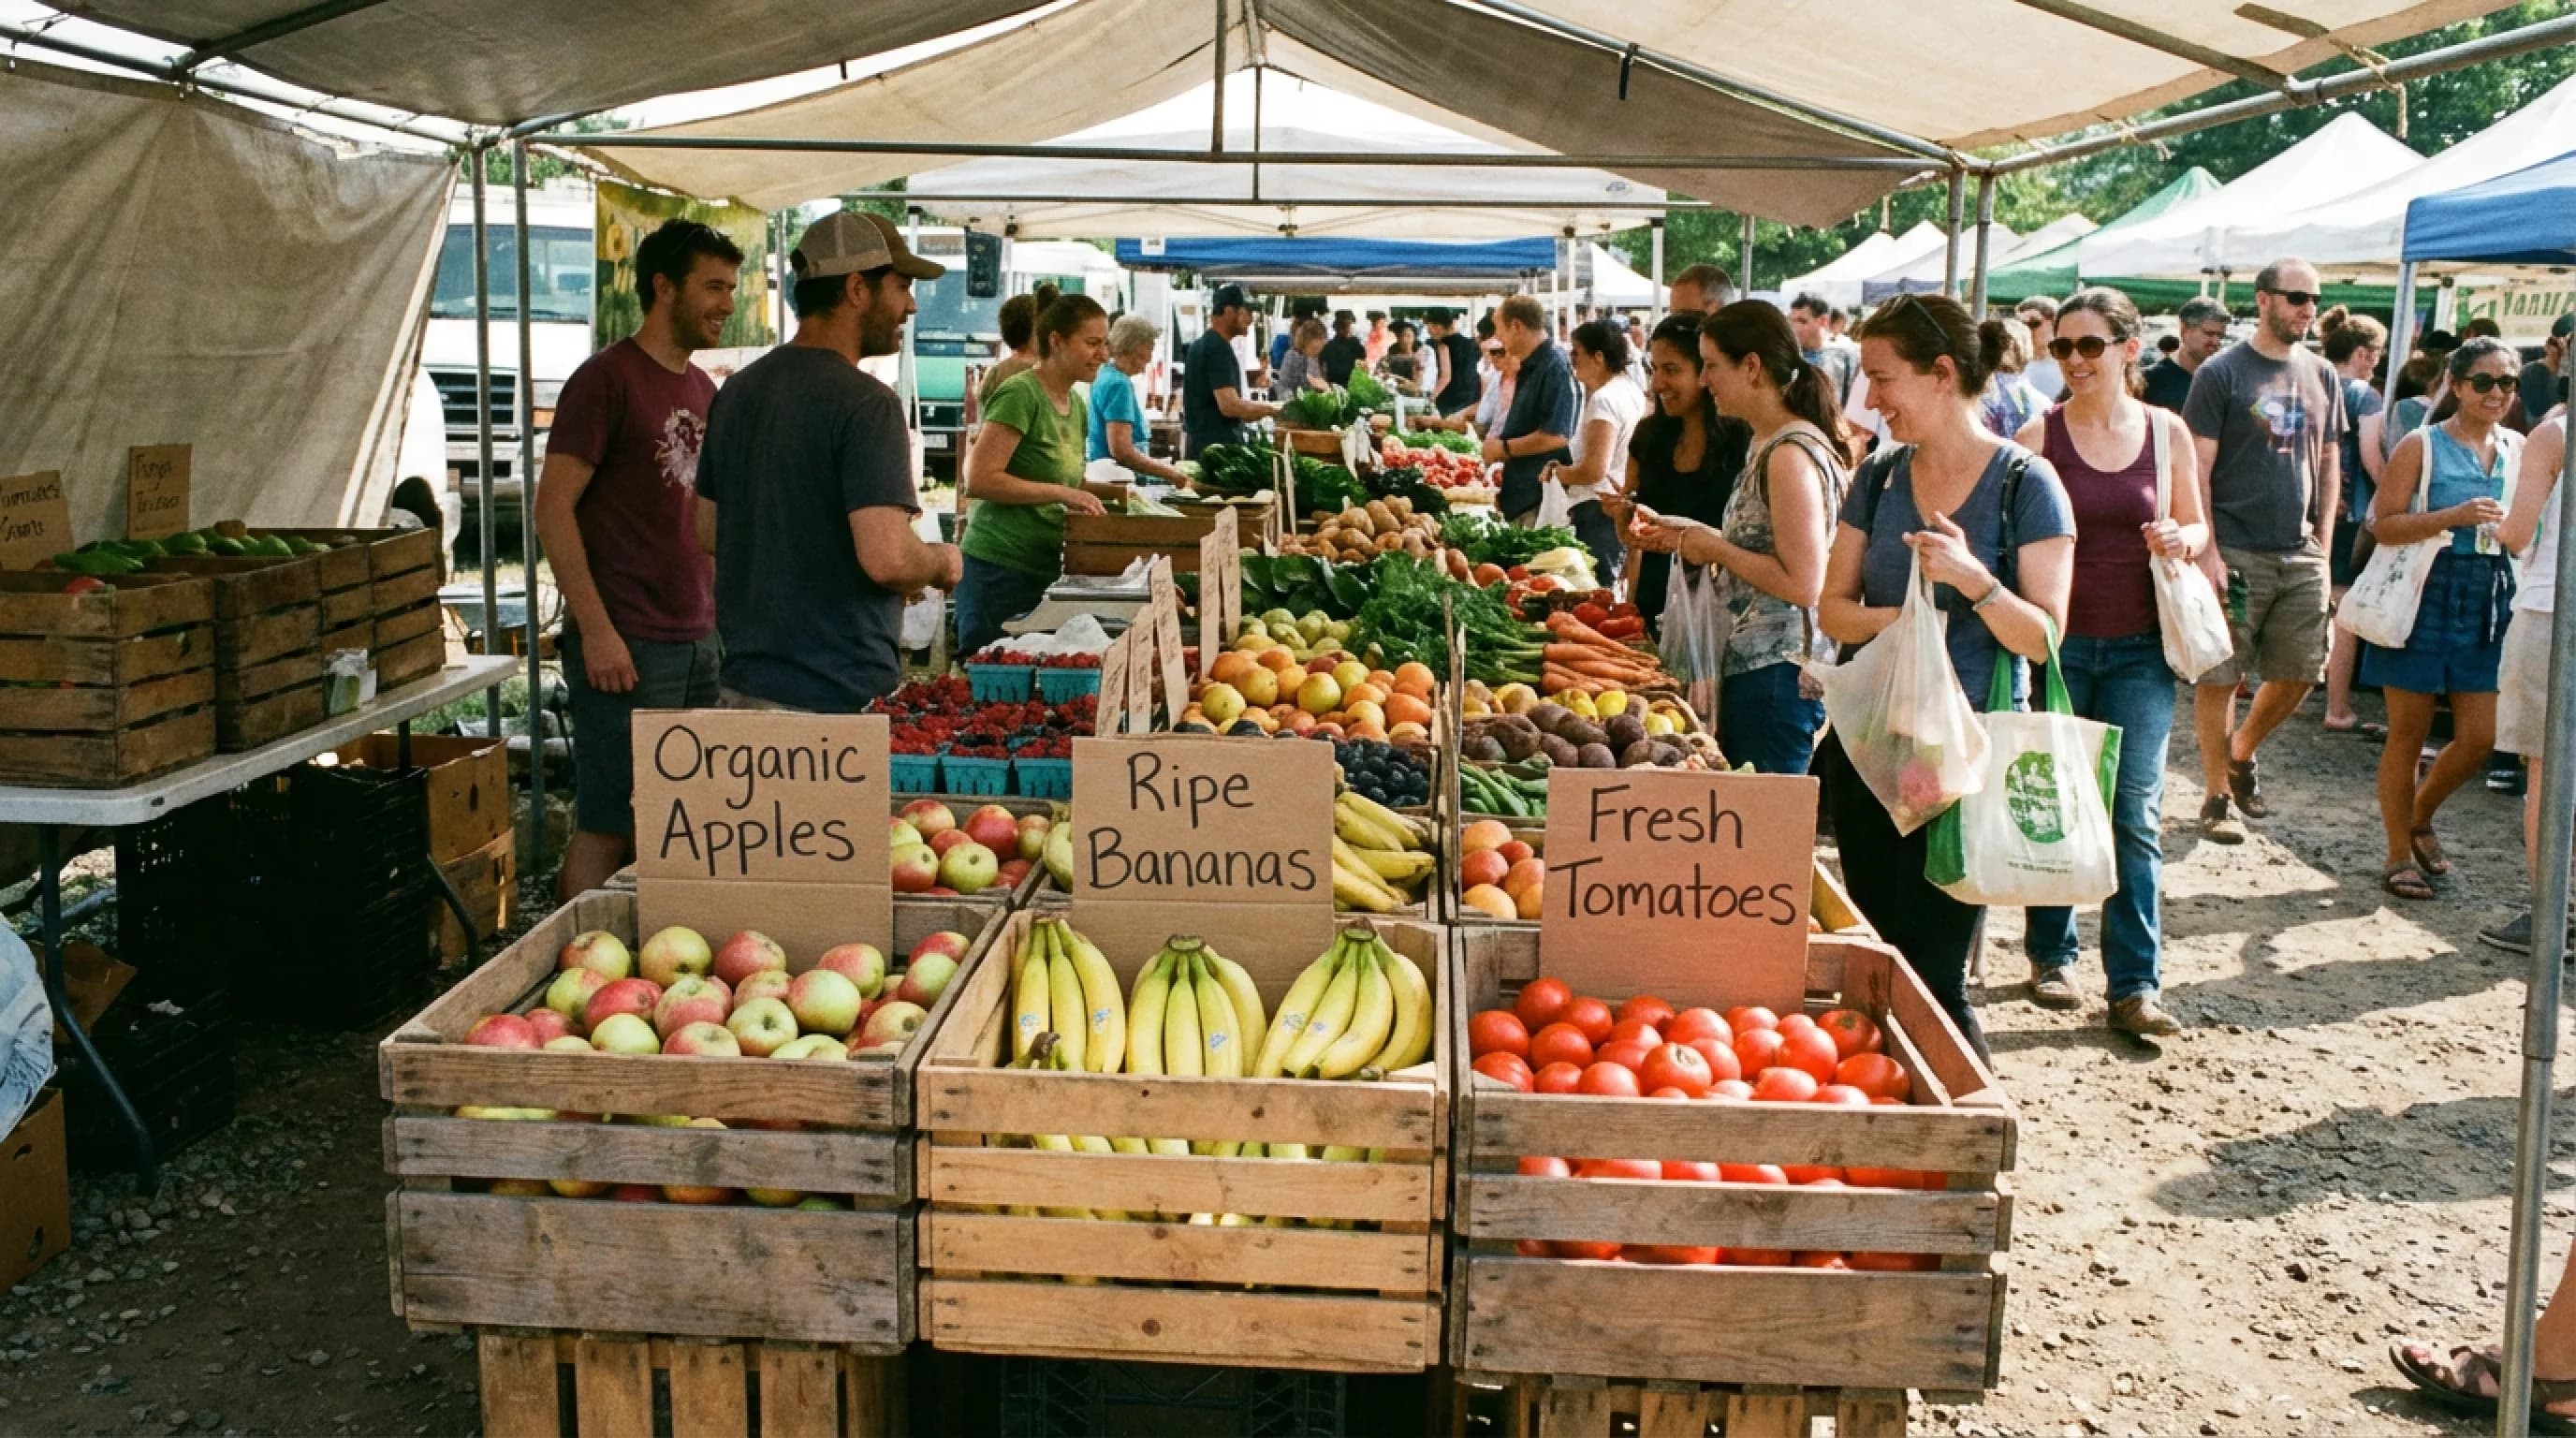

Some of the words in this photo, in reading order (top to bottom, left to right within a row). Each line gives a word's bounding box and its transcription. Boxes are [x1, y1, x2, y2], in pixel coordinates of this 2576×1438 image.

[654, 724, 867, 811] Organic
[1126, 752, 1254, 829] Ripe
[660, 798, 855, 877] Apples
[1589, 784, 1743, 849] Fresh
[1088, 827, 1317, 890] Bananas
[1548, 857, 1796, 926] Tomatoes
